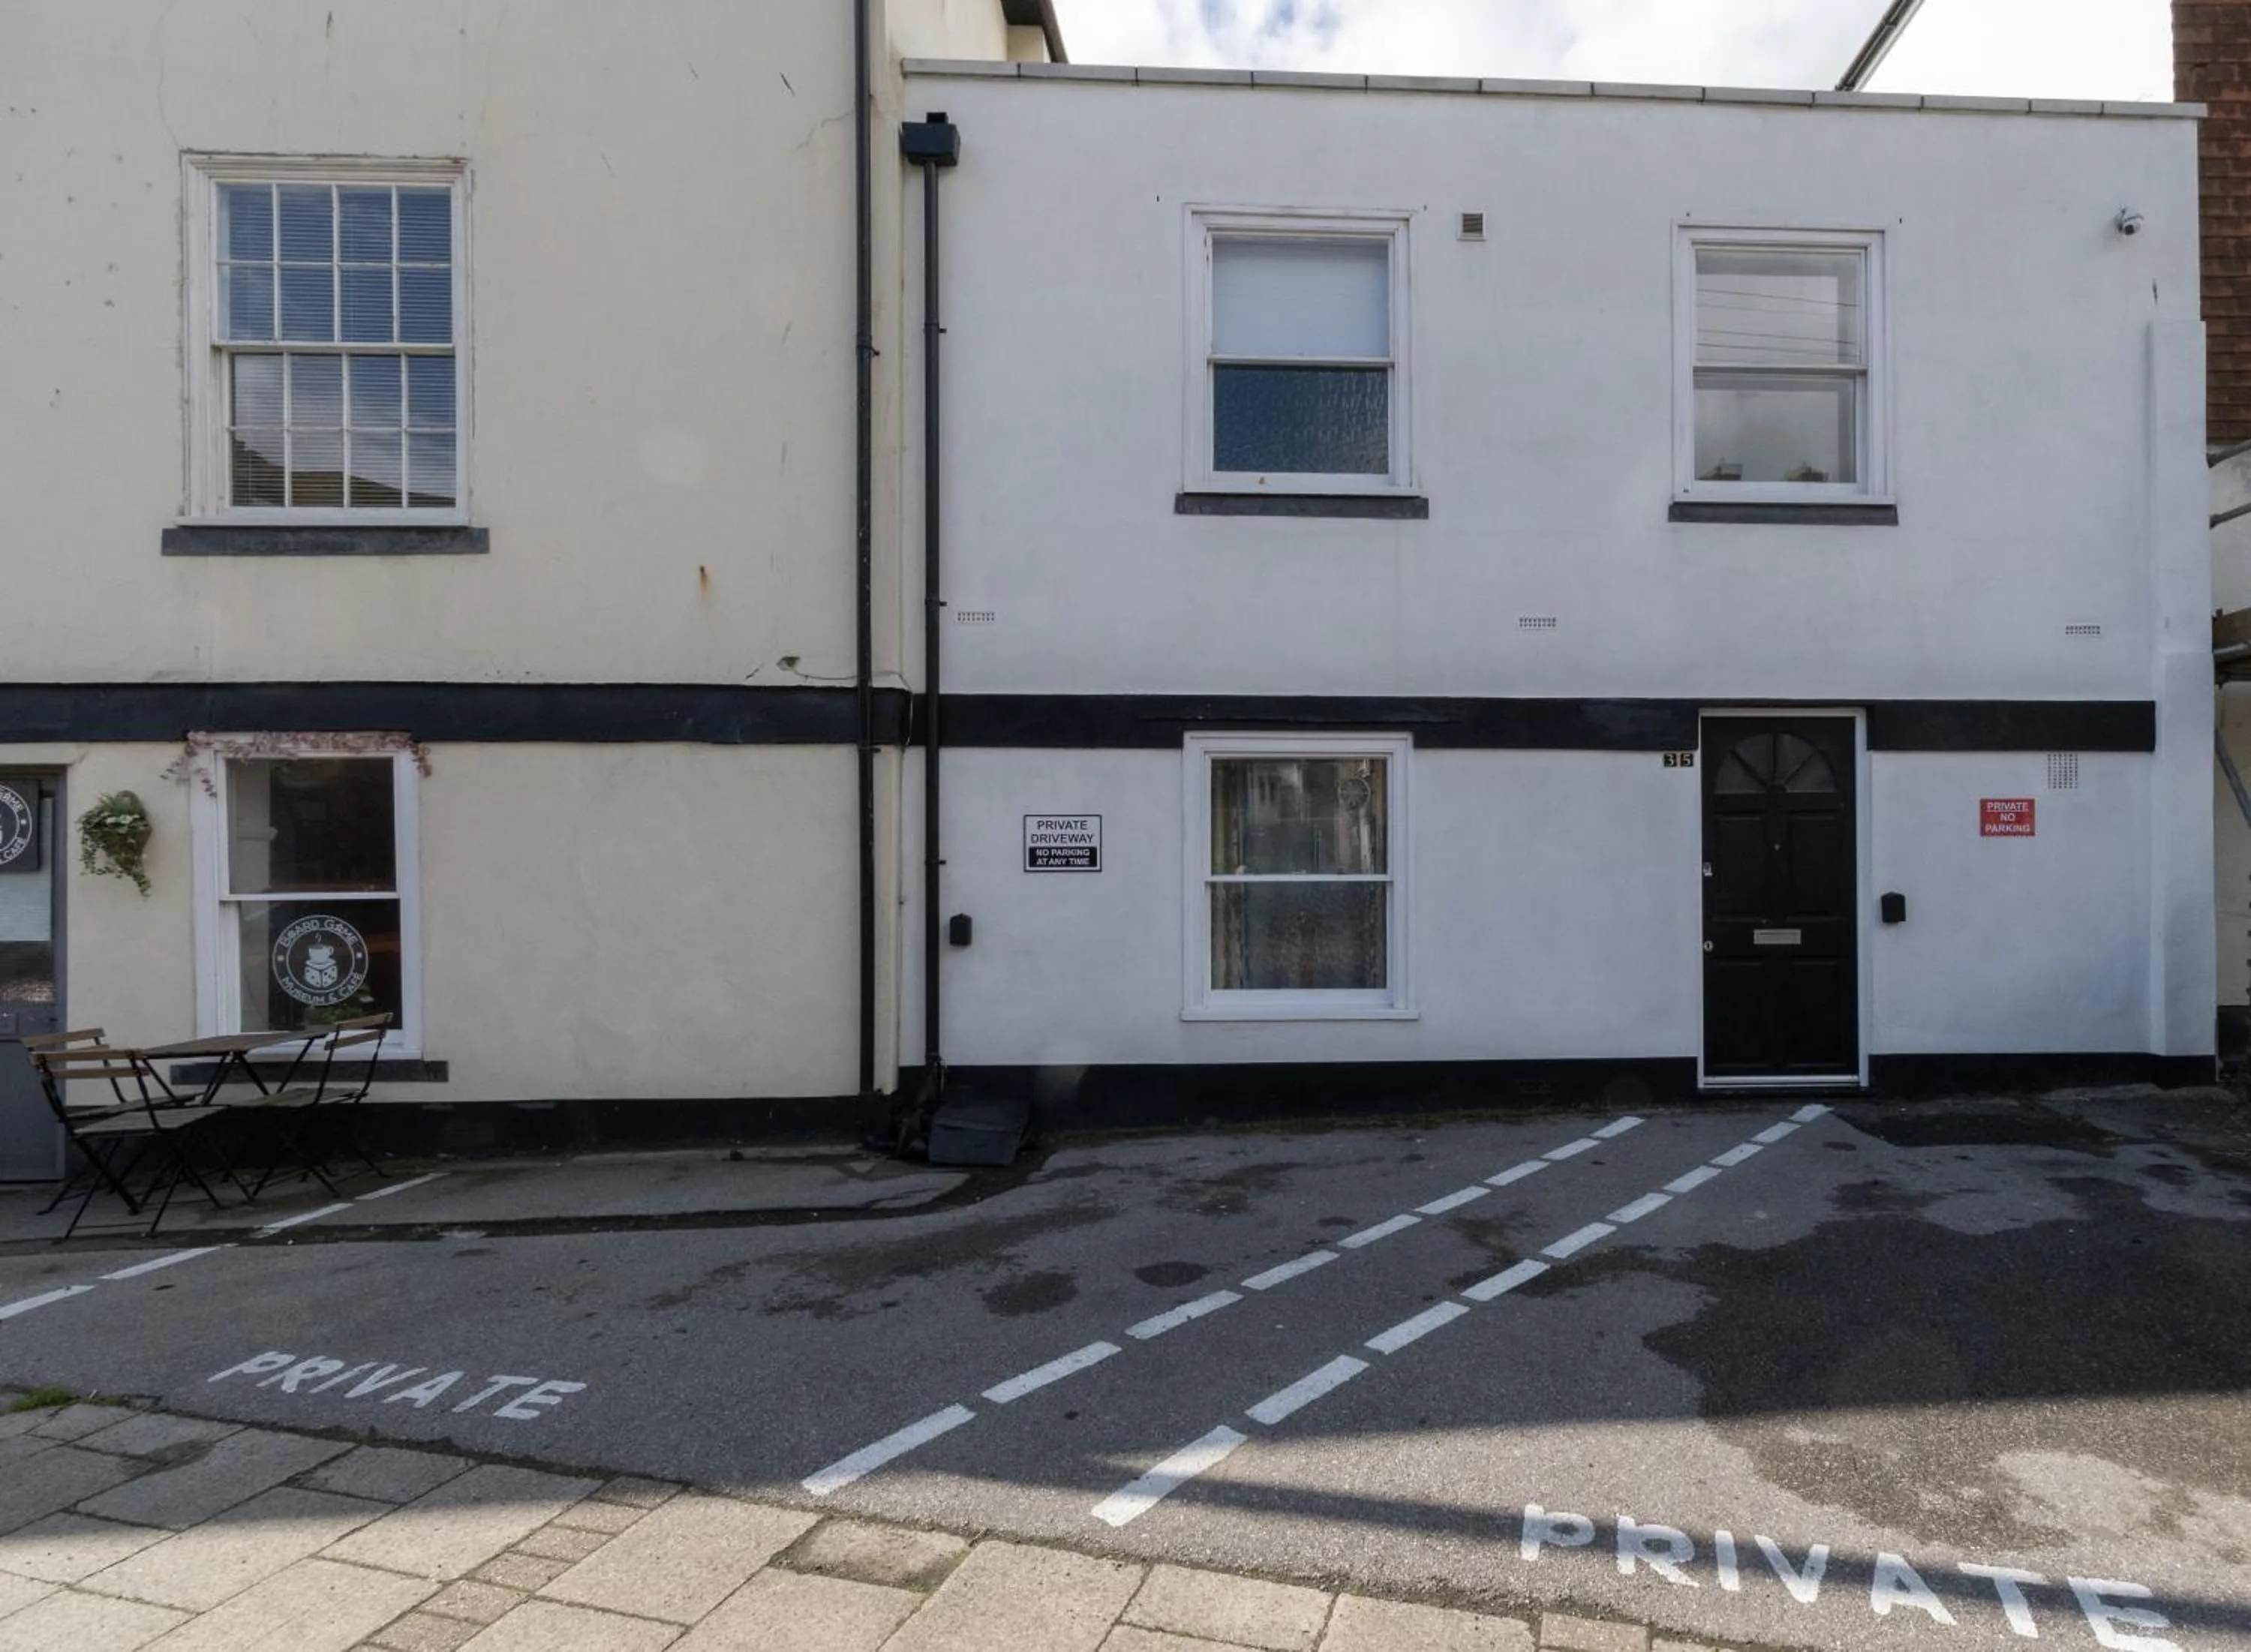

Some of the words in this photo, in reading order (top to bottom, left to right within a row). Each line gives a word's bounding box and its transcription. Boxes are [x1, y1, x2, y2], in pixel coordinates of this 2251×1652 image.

[1665, 753, 1692, 767] 35
[1985, 802, 2029, 811] PRIVATE
[2000, 812, 2016, 821] NO
[1036, 820, 1088, 830] PRIVATE
[1985, 824, 2030, 833] PARKING
[1030, 834, 1093, 843] DRIVEWAY
[207, 1351, 588, 1419] PRIVATE
[1520, 1503, 2182, 1651] PRIVATE
